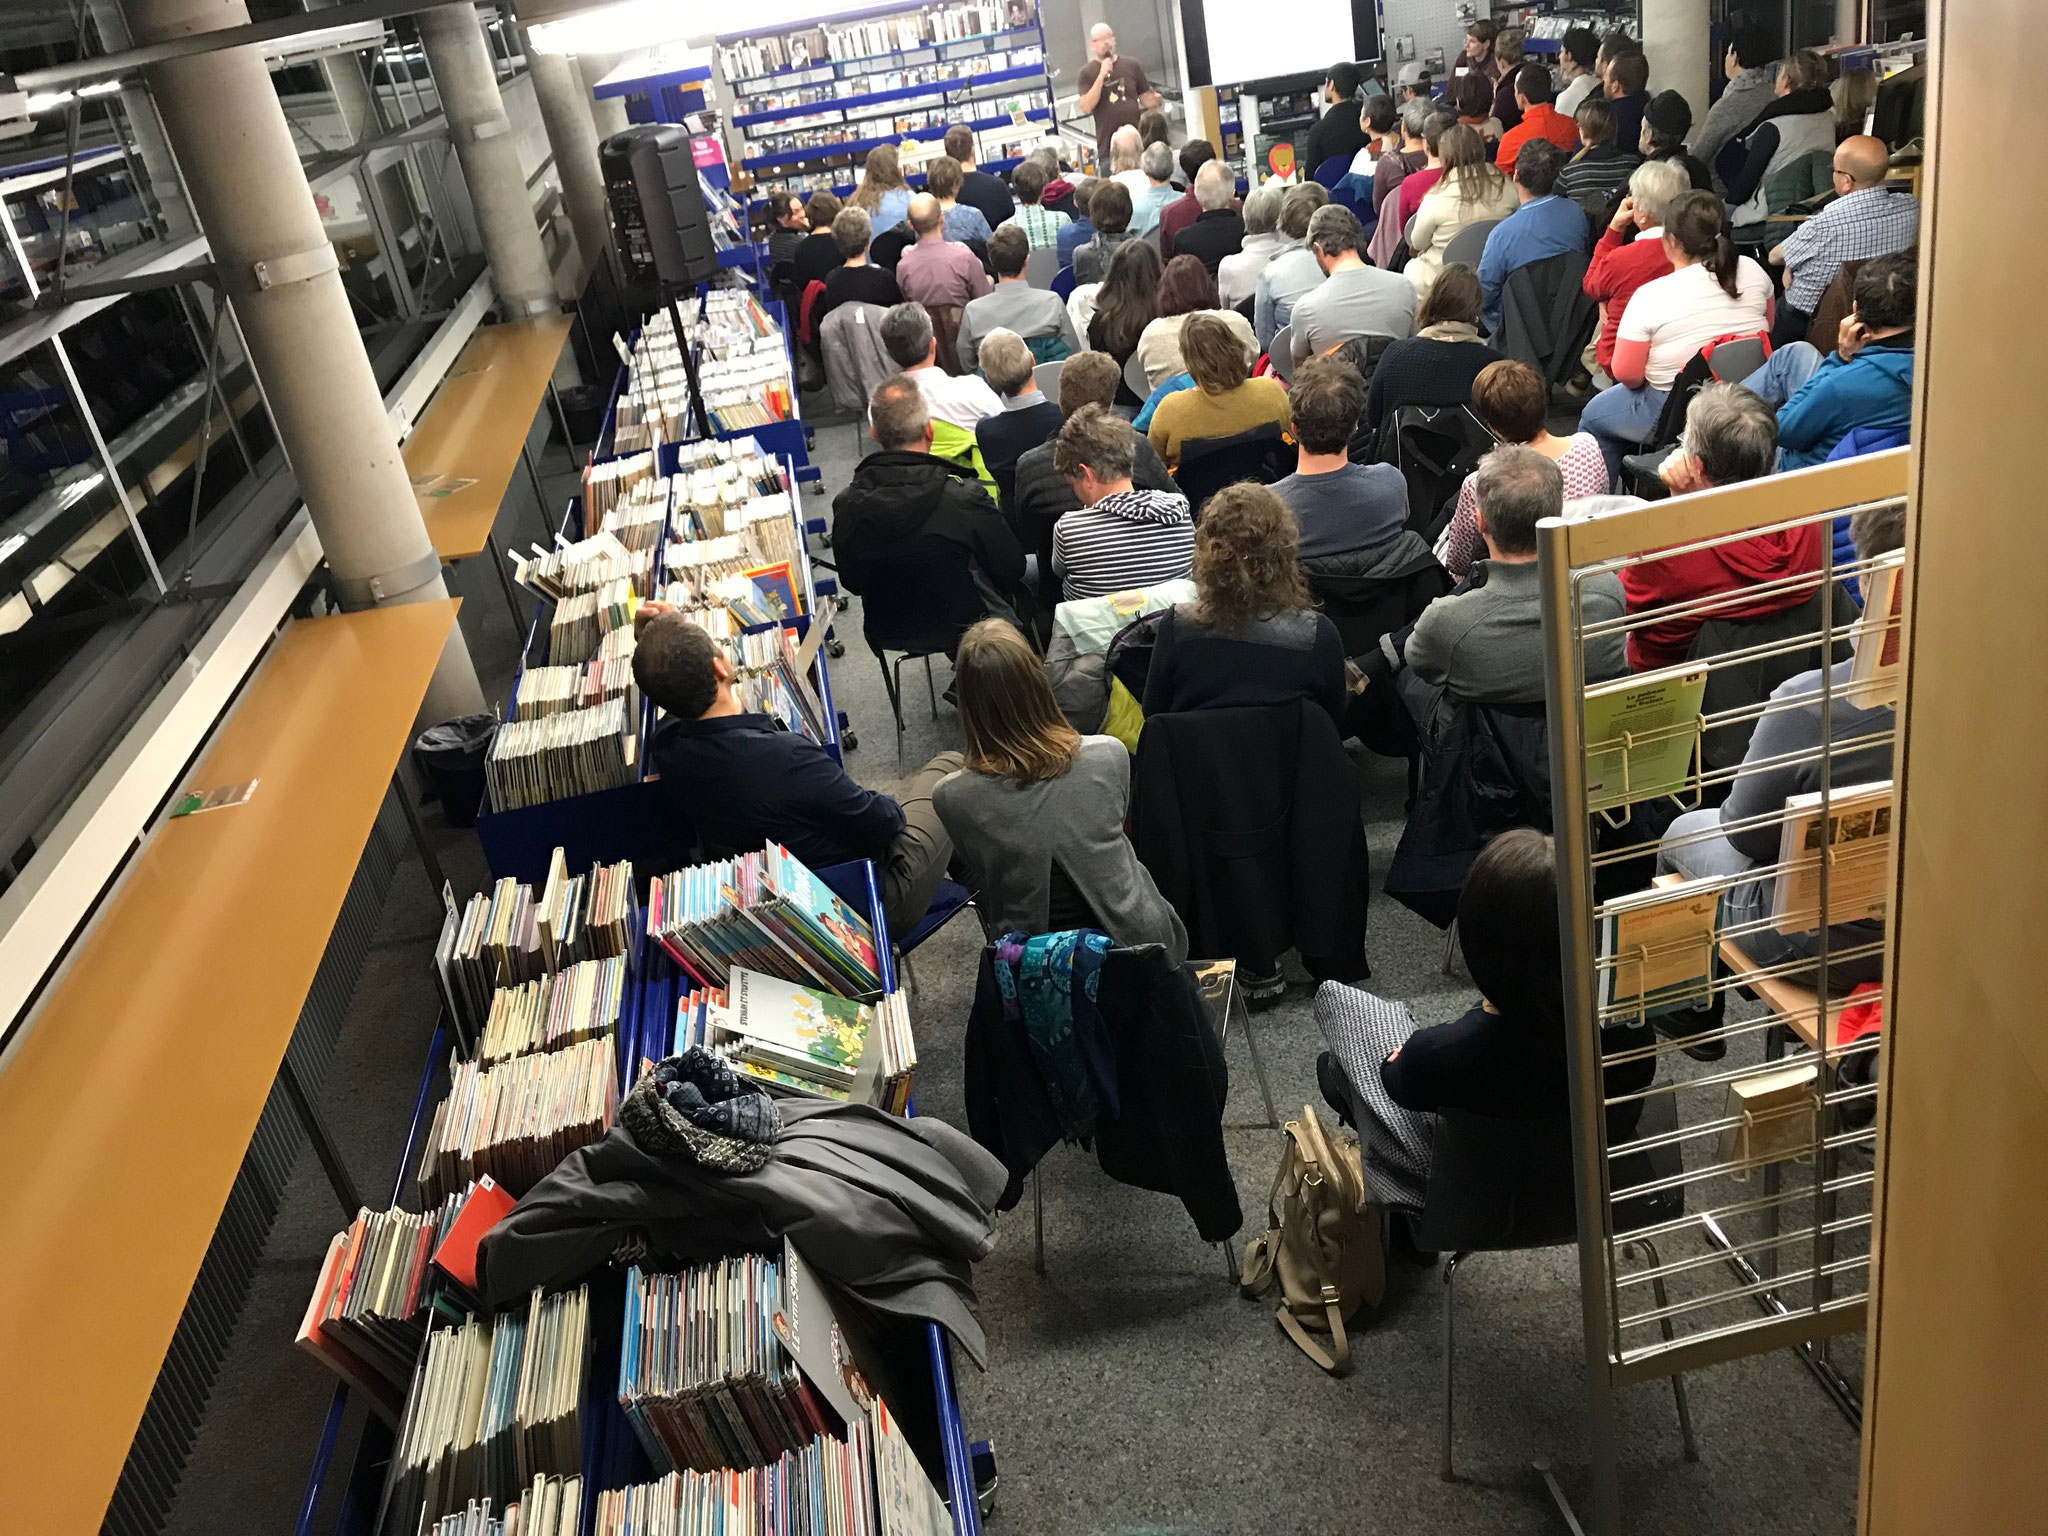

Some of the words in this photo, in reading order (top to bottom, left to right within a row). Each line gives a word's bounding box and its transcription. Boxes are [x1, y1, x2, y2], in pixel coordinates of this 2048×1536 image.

[789, 1247, 800, 1300] SPIROU
[791, 1298, 800, 1332] PETIT
[791, 1331, 801, 1354] LE
